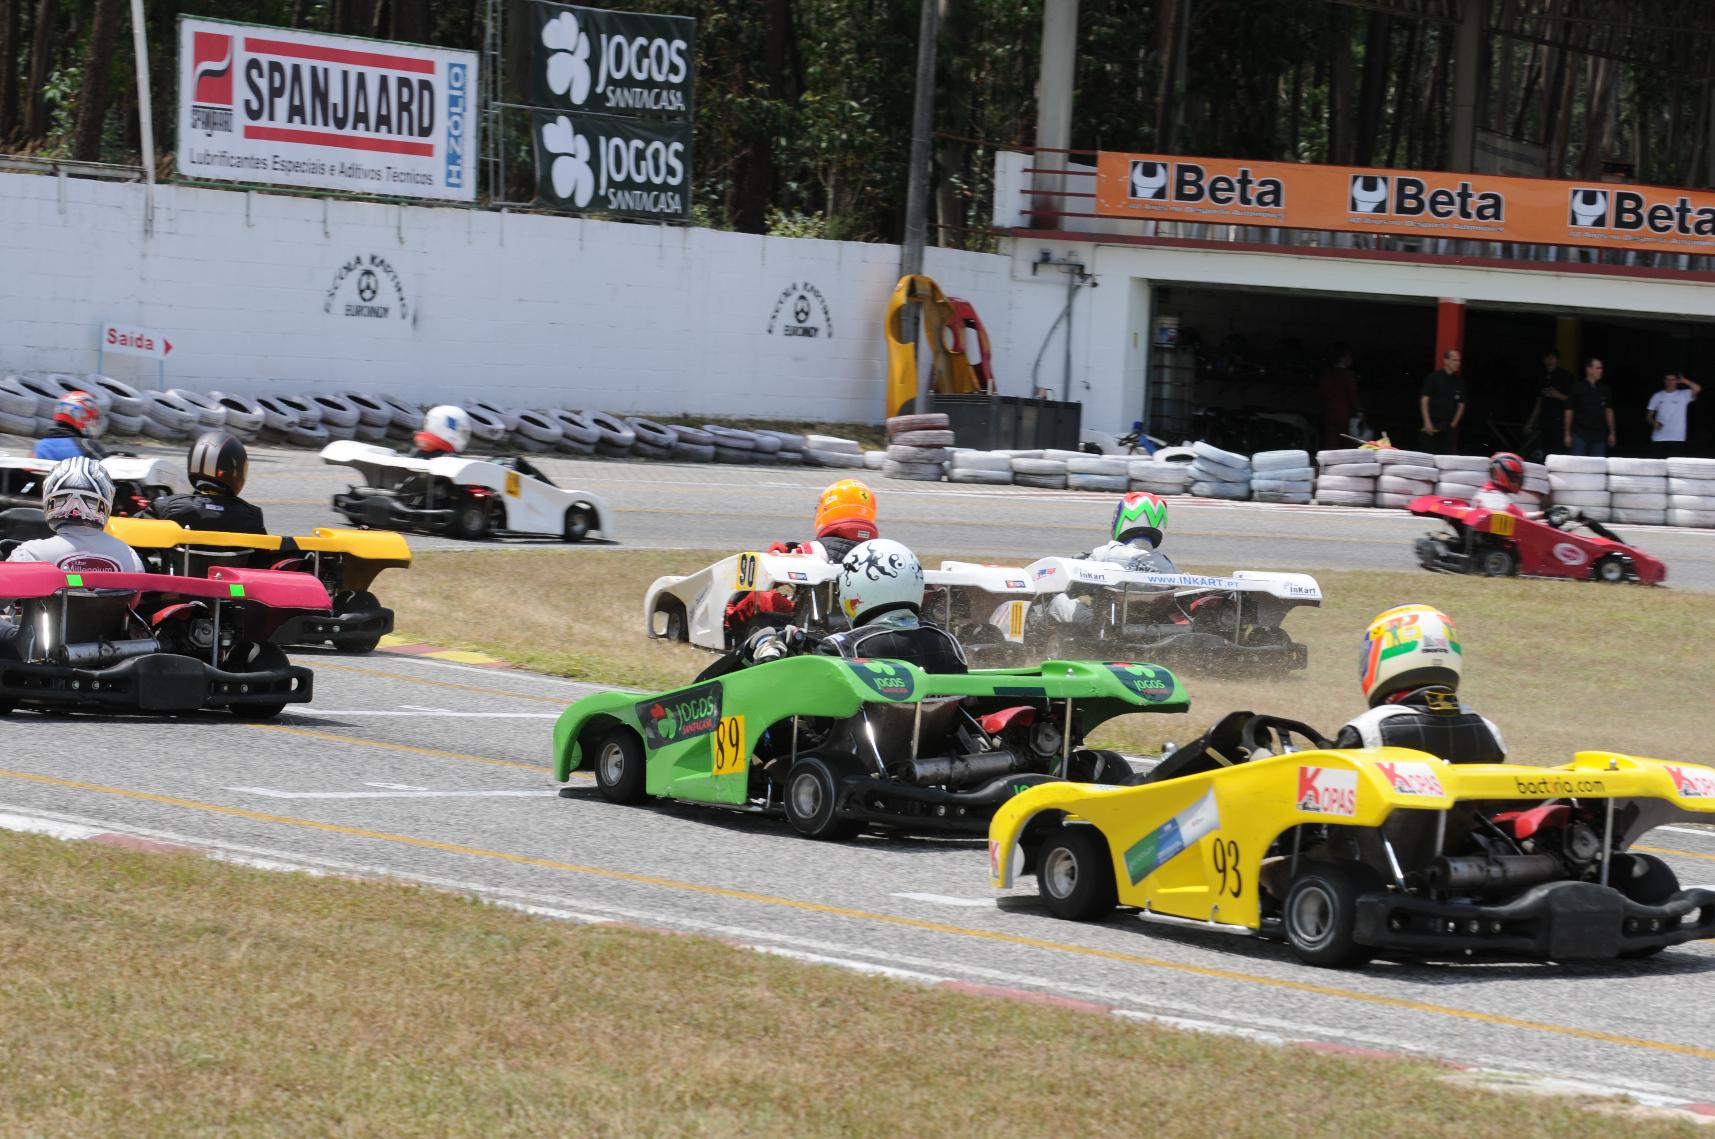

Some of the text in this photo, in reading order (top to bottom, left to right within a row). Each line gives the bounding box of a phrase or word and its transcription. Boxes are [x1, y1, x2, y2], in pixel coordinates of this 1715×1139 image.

[595, 33, 688, 94] JOGOS
[244, 57, 435, 138] SPANJAARD
[189, 148, 268, 170] Lubrificantes
[272, 154, 326, 176] Especiais
[329, 164, 336, 176] e
[598, 136, 685, 196] JOGOS
[1174, 163, 1285, 208] Beta
[1396, 176, 1505, 222] Beta
[1614, 191, 1715, 236] Beta
[740, 554, 756, 587] 90
[1134, 680, 1165, 691] JOGOS
[676, 696, 714, 731] JOGOS
[716, 717, 740, 770] 89
[1213, 838, 1242, 898] 93
